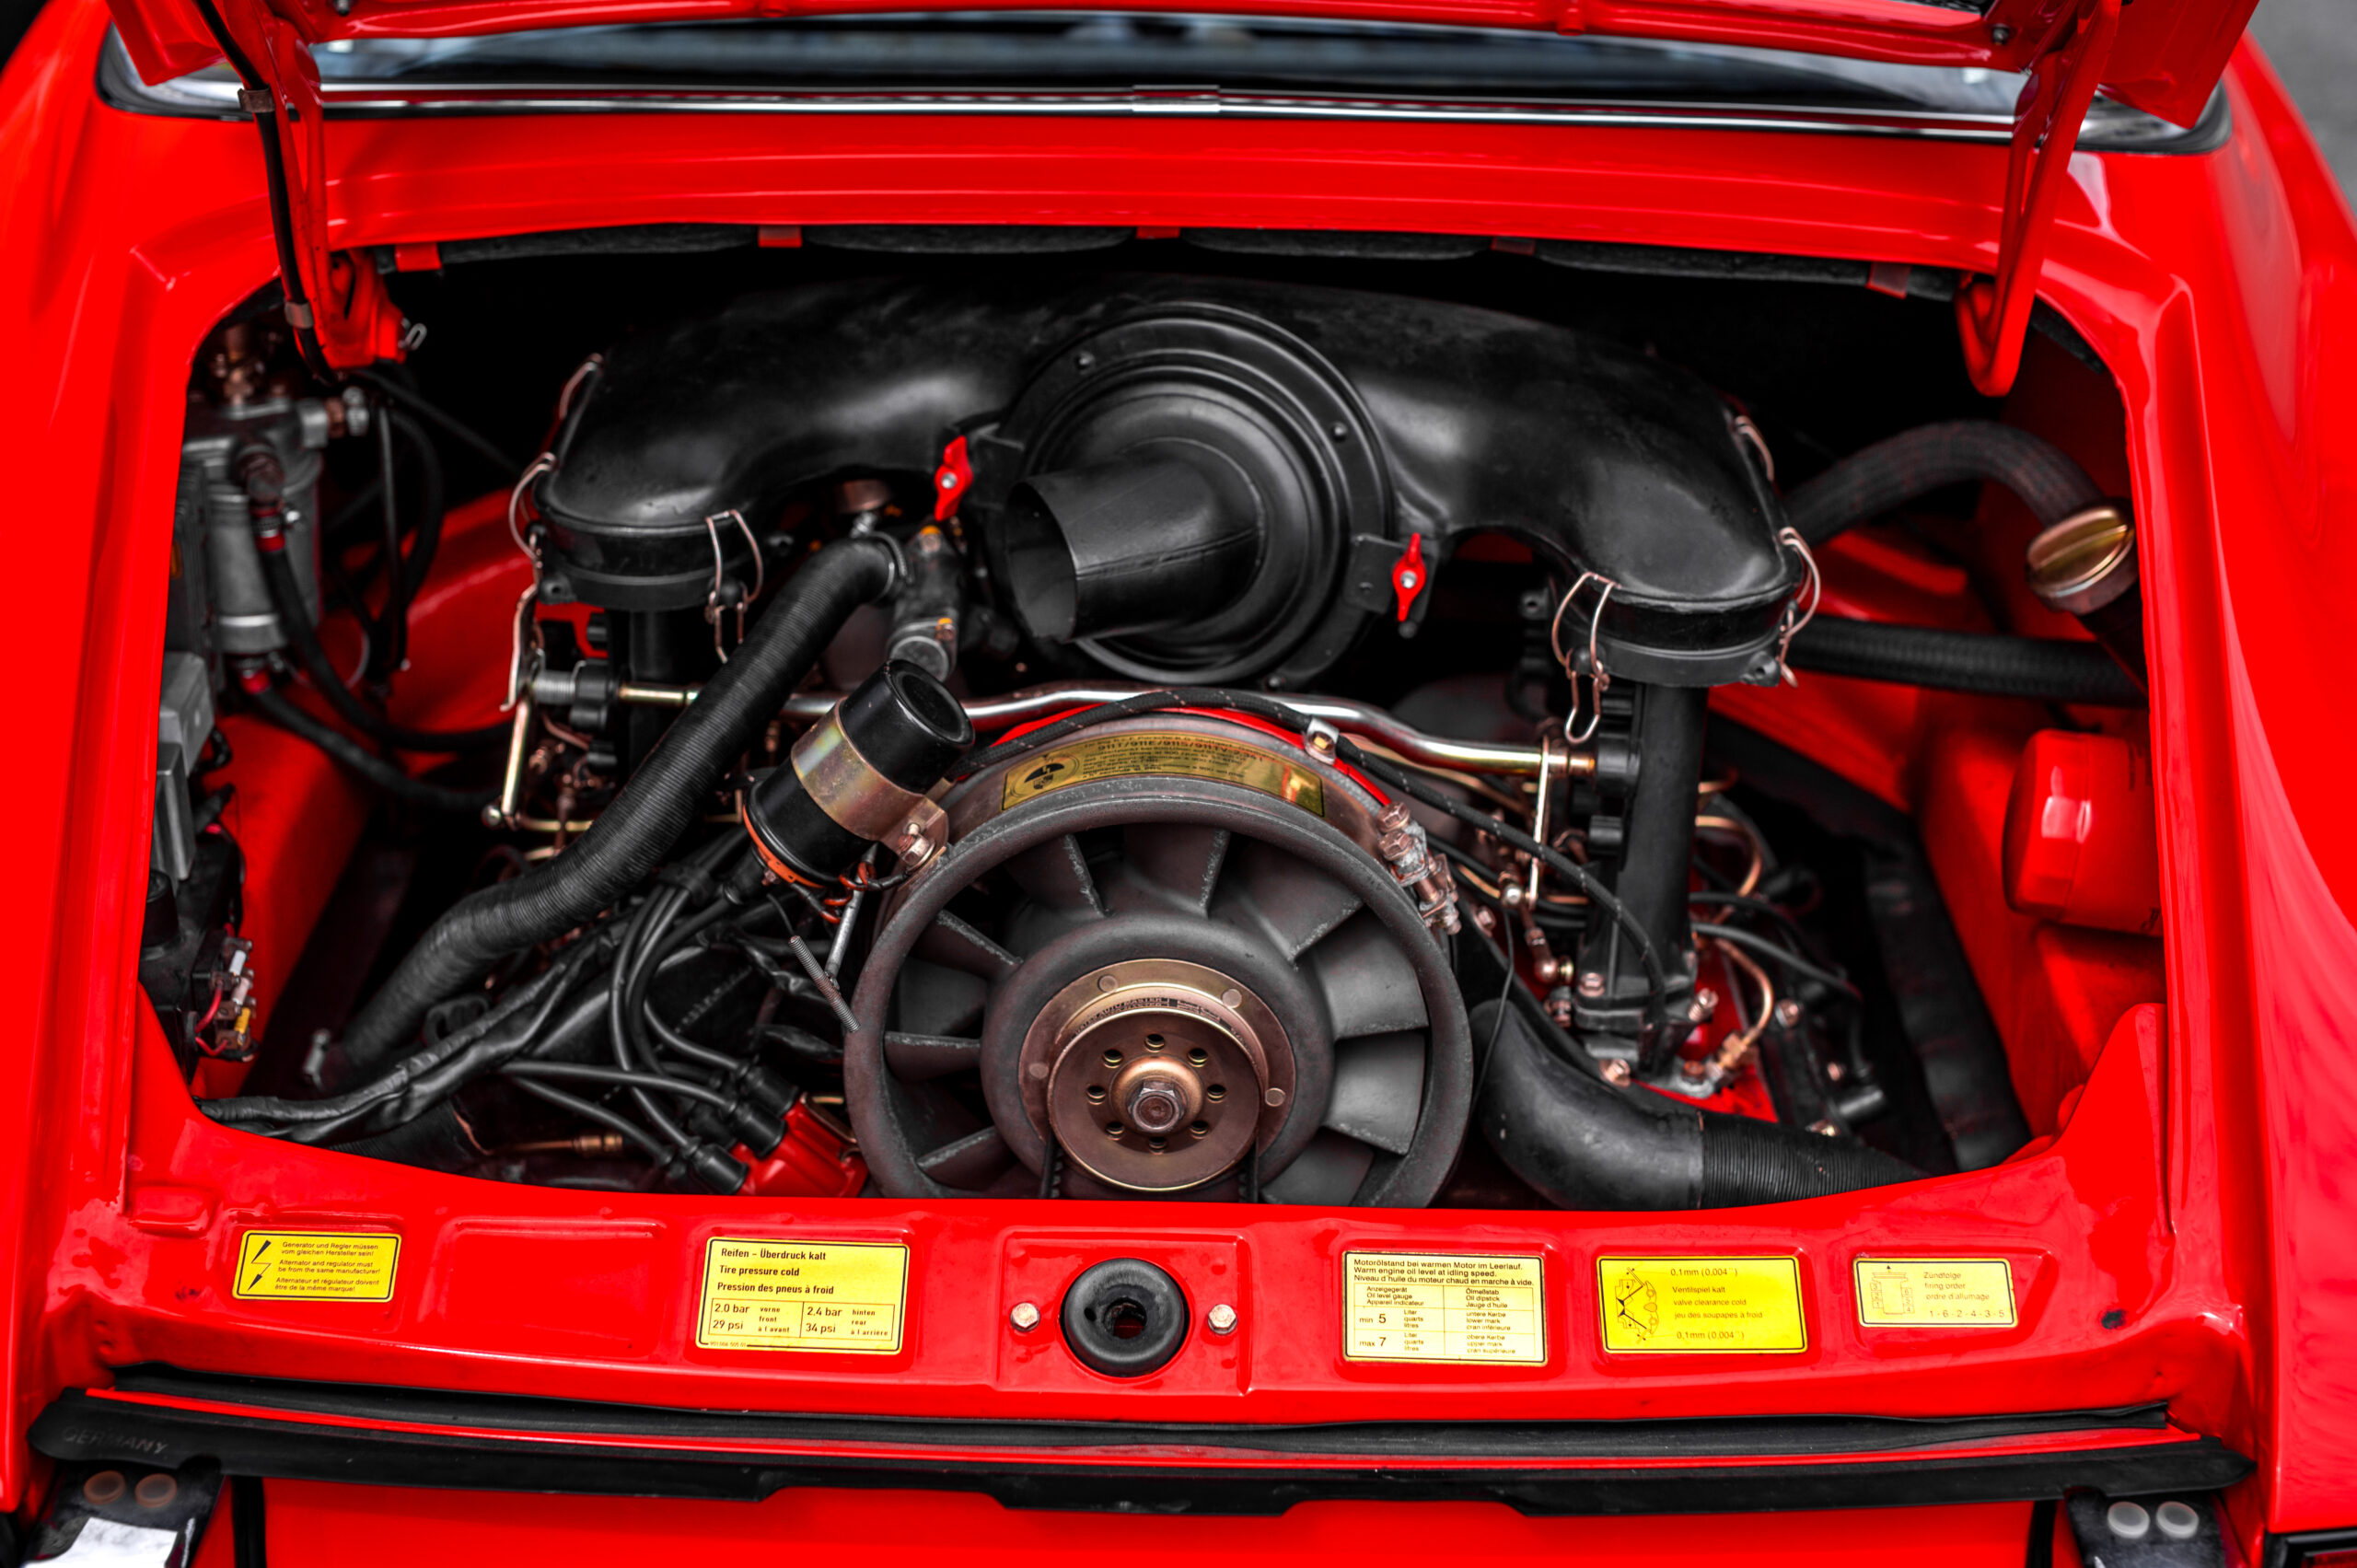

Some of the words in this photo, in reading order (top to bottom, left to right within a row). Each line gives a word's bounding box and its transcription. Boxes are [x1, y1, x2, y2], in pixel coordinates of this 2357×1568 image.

[721, 1249, 749, 1258] Reifen
[761, 1249, 806, 1260] Überdruck
[808, 1251, 826, 1260] kalt
[1354, 1259, 1404, 1267] Motorölstand
[720, 1265, 736, 1273] Tire
[738, 1267, 778, 1276] pressure
[781, 1267, 799, 1276] cold
[1379, 1268, 1404, 1276] engine
[1447, 1270, 1469, 1278] idling
[1471, 1270, 1496, 1278] speed.
[717, 1283, 755, 1292] Pression
[758, 1283, 773, 1292] des
[776, 1285, 802, 1295] pneus
[805, 1285, 810, 1294] à
[813, 1285, 833, 1295] froid
[733, 1305, 749, 1314] bar
[825, 1307, 842, 1317] bar
[1378, 1313, 1386, 1324] 5
[1675, 1311, 1688, 1319] jeu
[713, 1320, 725, 1330] 29
[727, 1321, 743, 1331] psi
[806, 1323, 818, 1332] 34
[820, 1324, 836, 1334] psi
[1379, 1337, 1386, 1347] 7
